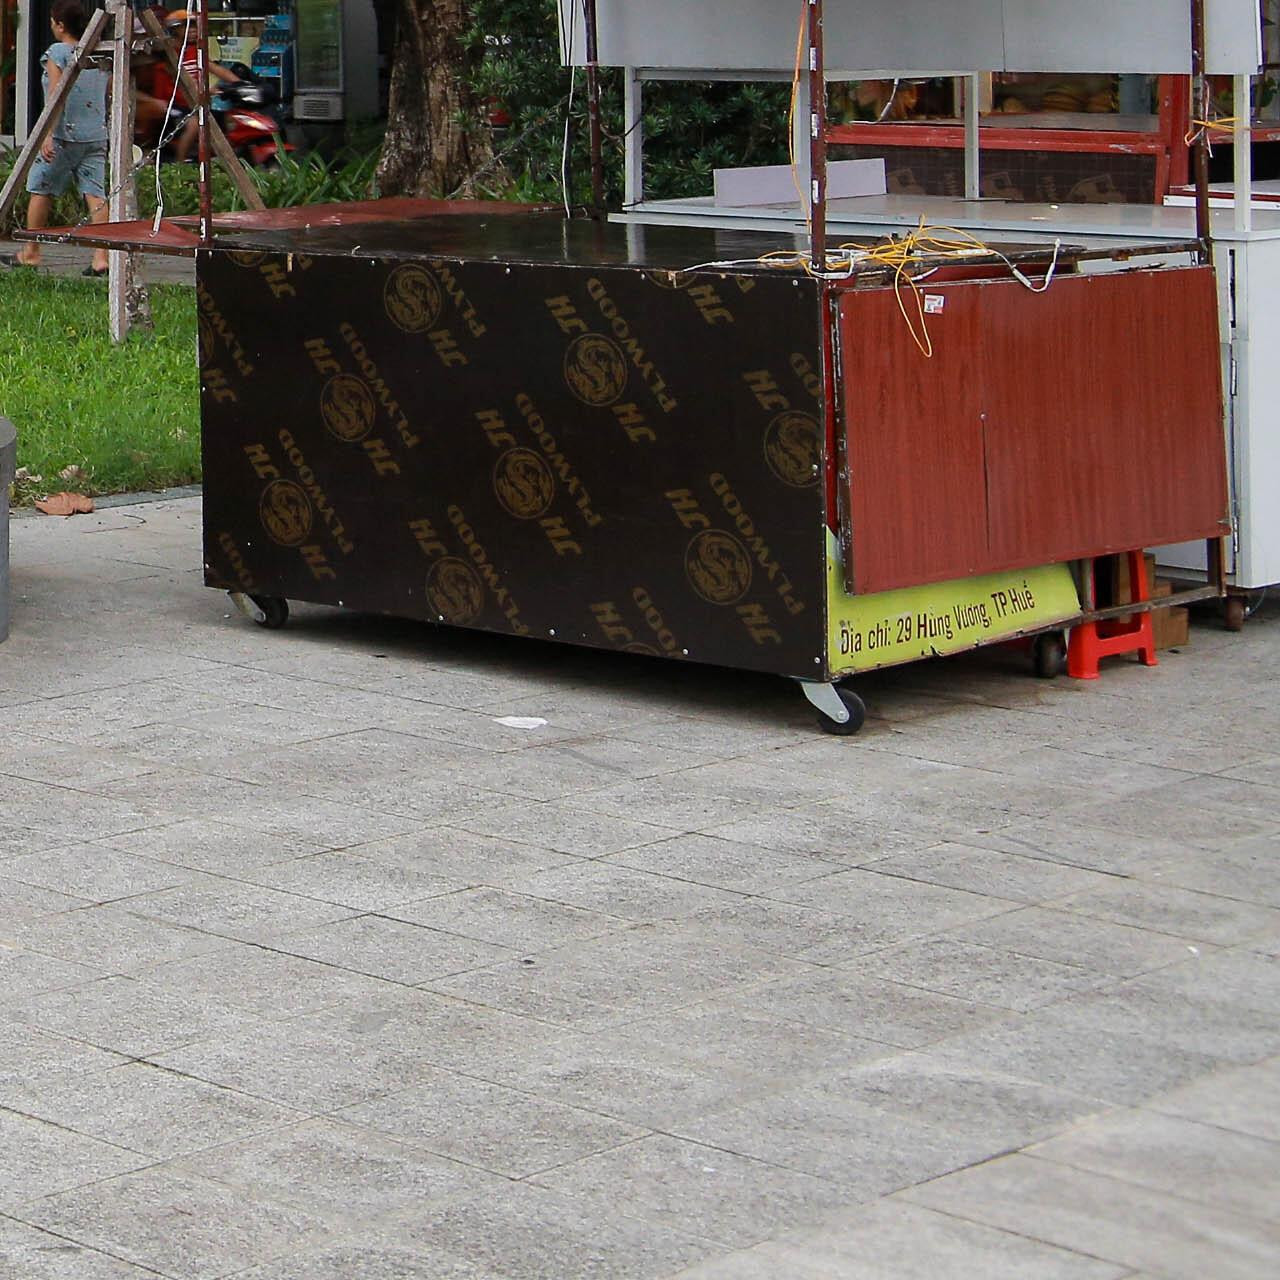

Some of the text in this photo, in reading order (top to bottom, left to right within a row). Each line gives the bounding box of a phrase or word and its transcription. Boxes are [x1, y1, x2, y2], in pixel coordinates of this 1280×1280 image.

[340, 322, 421, 448] PLYWOOD
[588, 276, 678, 413] PLYWOOD
[515, 393, 602, 527] PLYWOOD
[709, 472, 806, 616] PLYWOOD
[841, 623, 862, 659] Địa
[896, 616, 912, 643] 29
